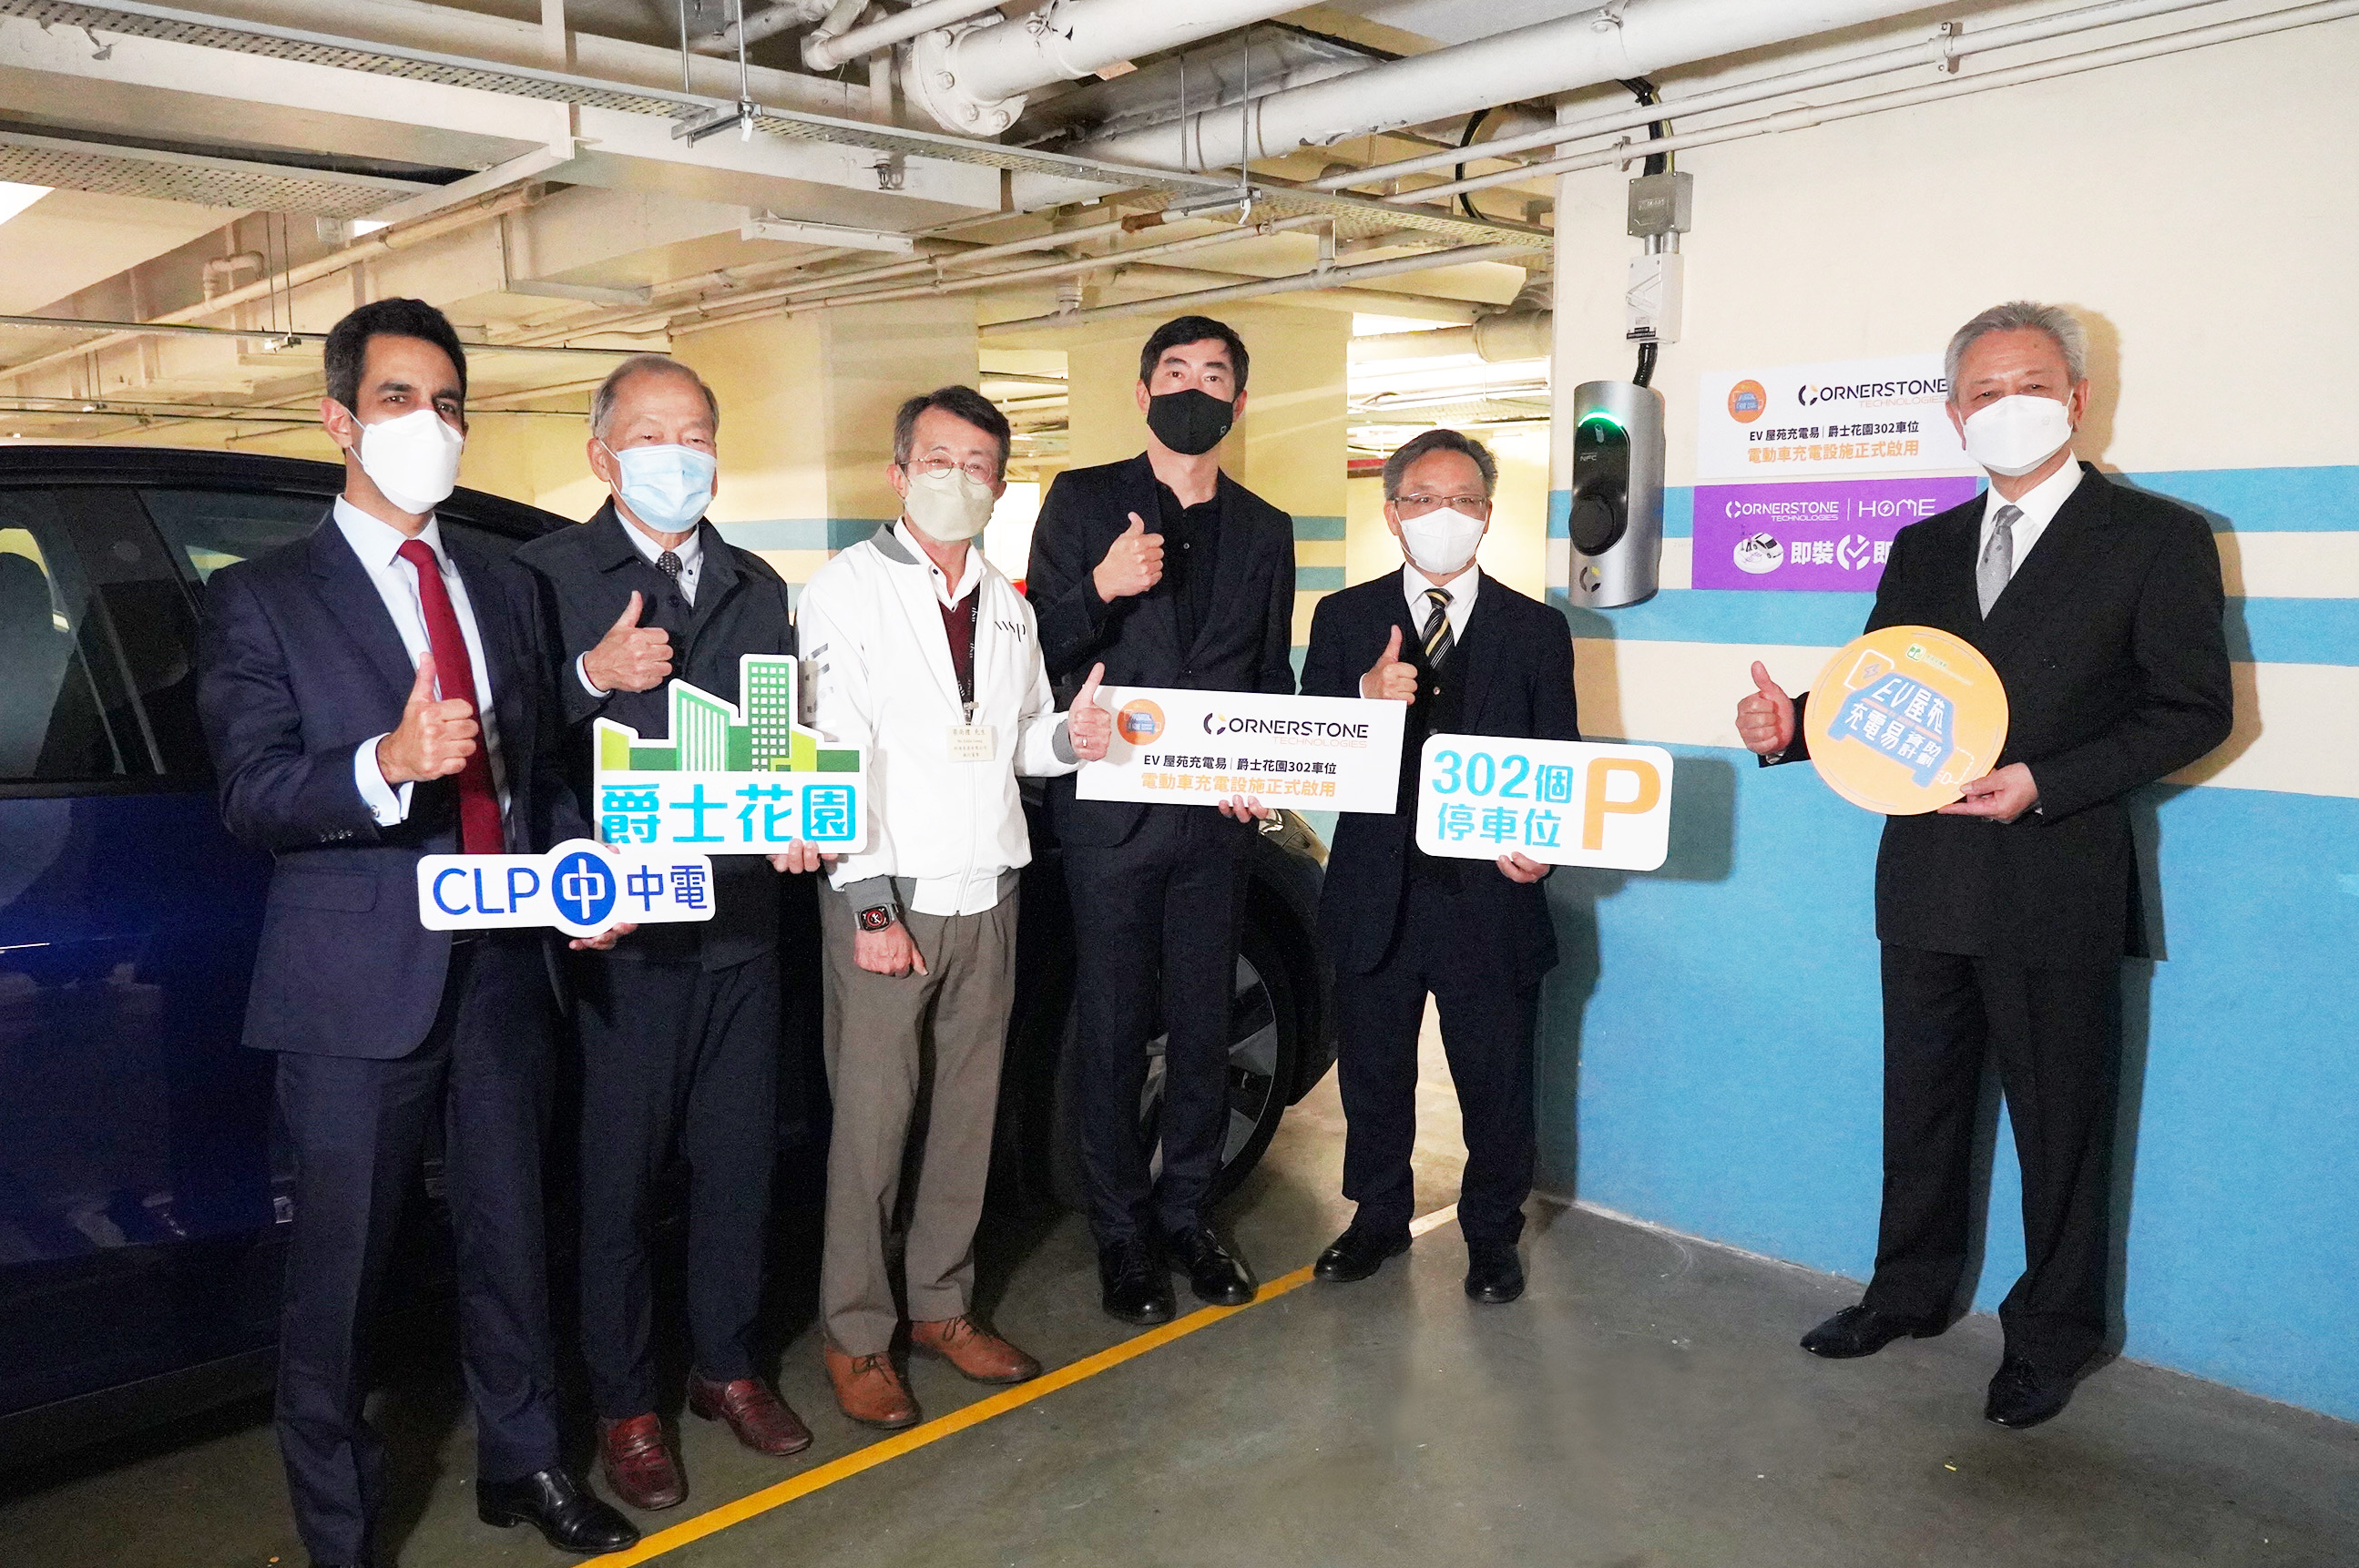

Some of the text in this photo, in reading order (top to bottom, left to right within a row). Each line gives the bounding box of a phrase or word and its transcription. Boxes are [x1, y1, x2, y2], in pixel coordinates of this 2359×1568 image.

[1798, 378, 1948, 406] CORNERSTONE
[1750, 421, 1919, 441] EV 屋苑充電易 爵士花園302車位
[1726, 499, 1936, 518] CORNERSTONE HOME
[1791, 541, 1834, 565] 即裝
[1203, 713, 1369, 738] CORNERSTONE
[1272, 737, 1367, 748] TECHNOLOGIES
[1144, 755, 1337, 775] EV 屋苑充電易 爵士花園302車位
[1432, 750, 1574, 803] 302個
[1141, 772, 1336, 797] 電動車充電設施正式啟用
[601, 783, 855, 844] 爵士花園
[1582, 758, 1660, 850] P
[1438, 802, 1561, 848] 停車位
[433, 867, 540, 915] CLP
[627, 864, 707, 911] 中電
